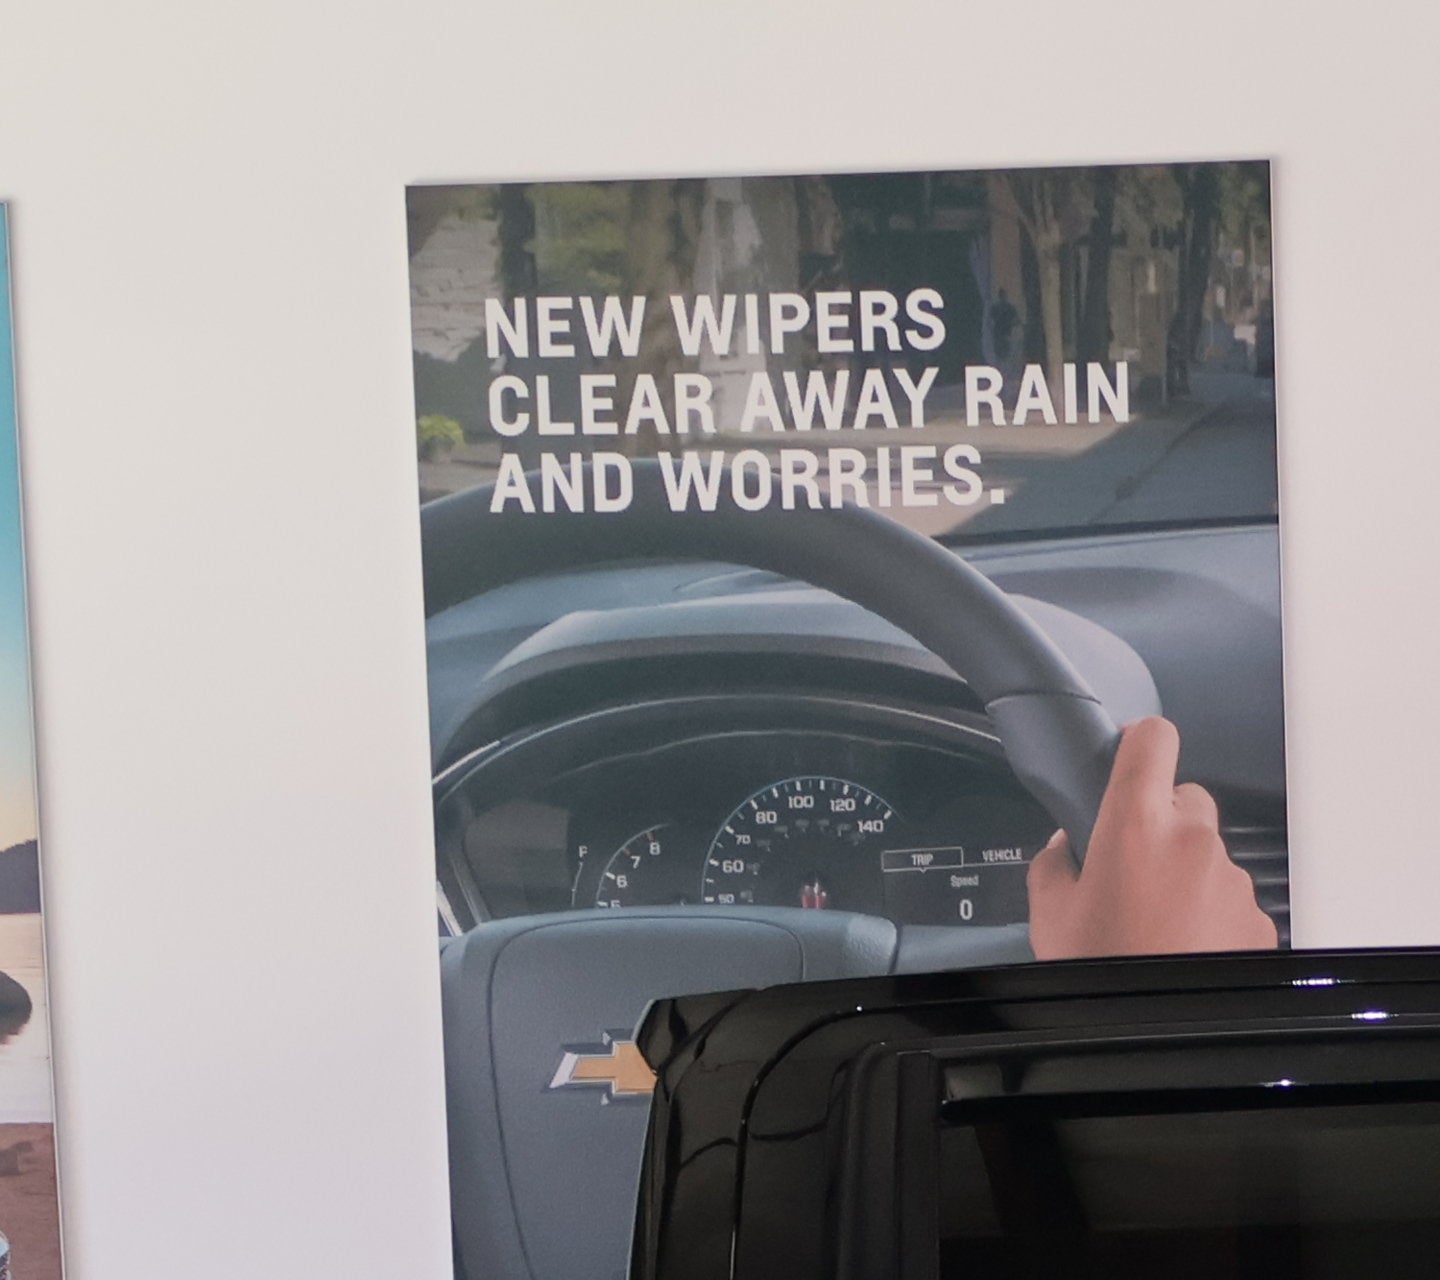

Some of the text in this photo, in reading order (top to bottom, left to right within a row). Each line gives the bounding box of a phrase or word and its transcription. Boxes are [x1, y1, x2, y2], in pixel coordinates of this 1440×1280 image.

[485, 288, 946, 359] NEW WIPERS
[488, 361, 1130, 436] CLEAR AWAY RAIN
[490, 444, 1006, 513] AND WORRIES.
[788, 796, 814, 809] 100
[830, 798, 856, 812] 120
[755, 811, 777, 824] 80
[857, 820, 884, 833] 140
[735, 834, 751, 845] 70
[649, 842, 660, 855] 8
[982, 848, 1022, 862] VEHICLE
[630, 855, 640, 869] 7
[911, 853, 934, 866] TRIP
[722, 860, 744, 873] 60
[616, 875, 627, 888] 6
[950, 874, 979, 887] Speed
[960, 899, 973, 920] 0
